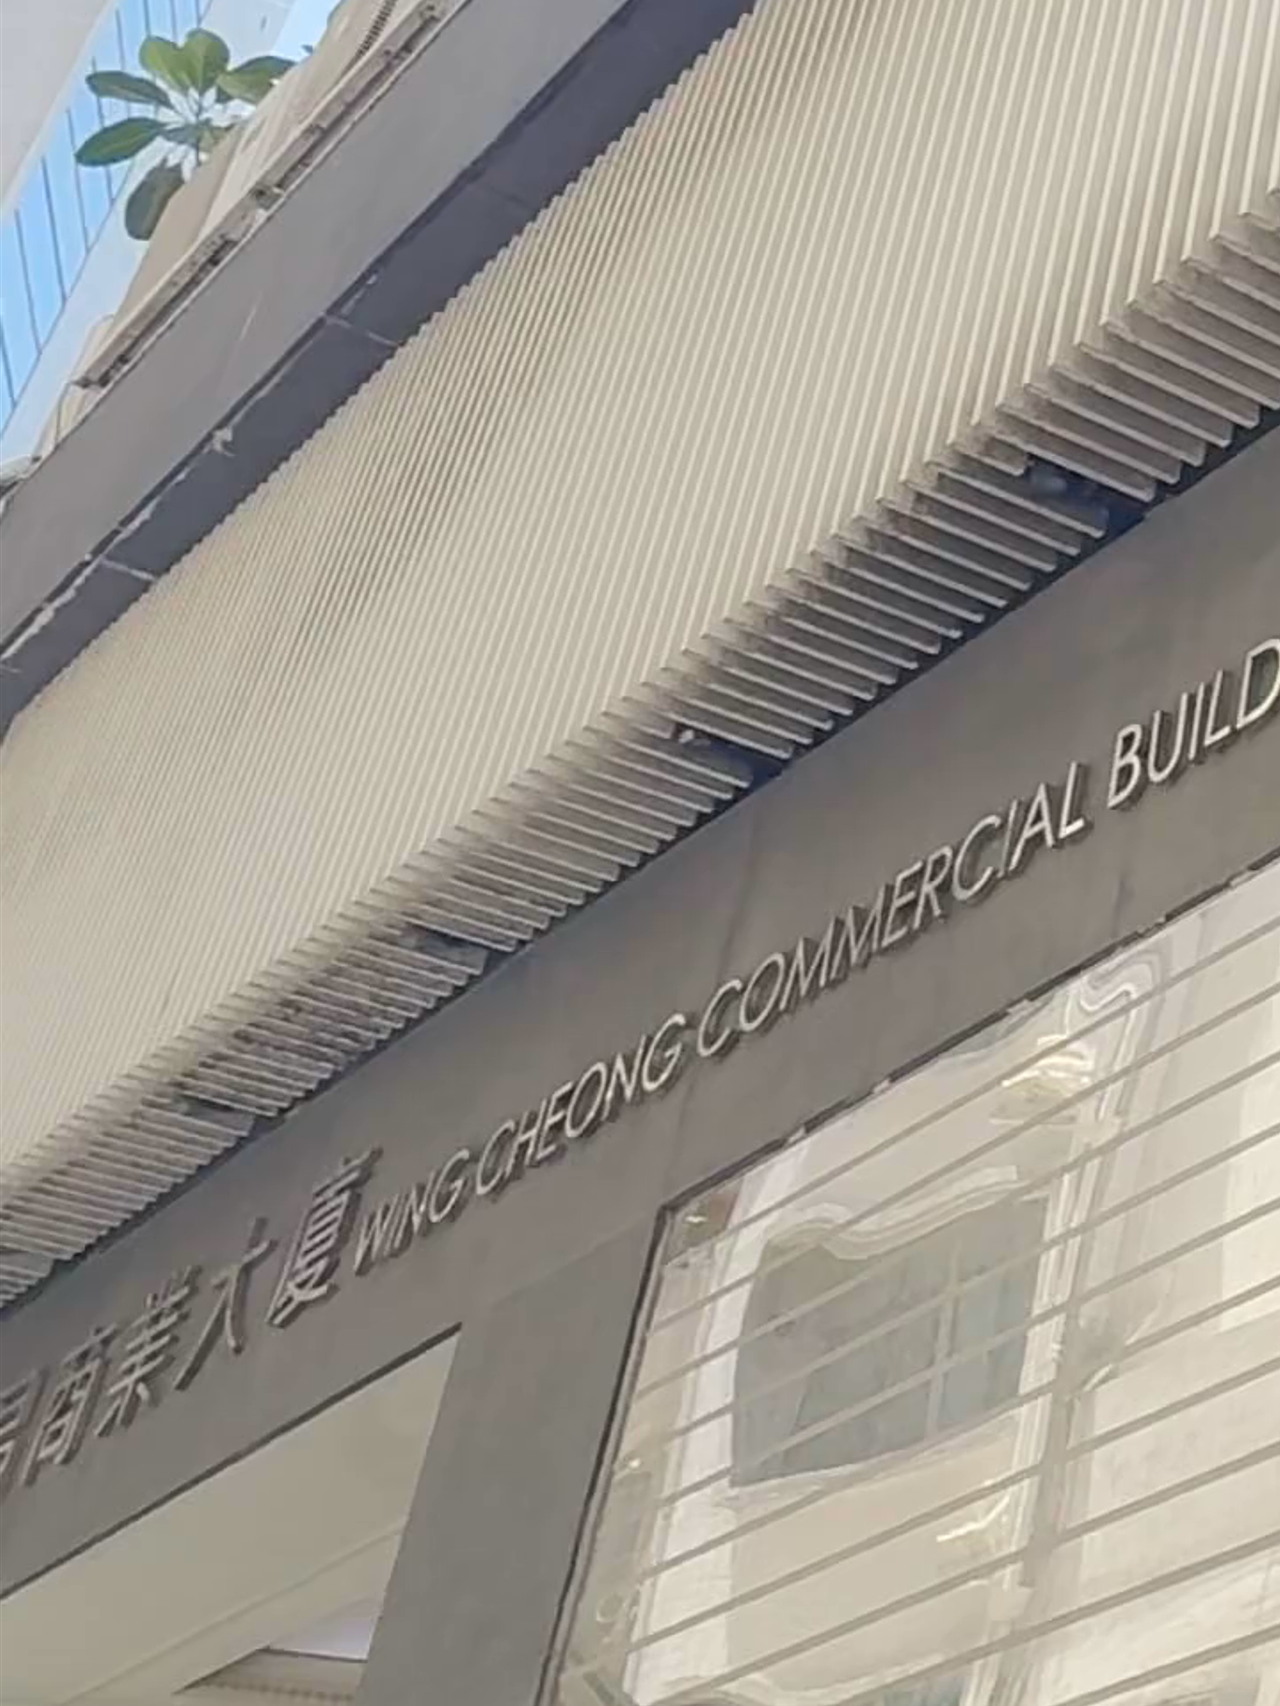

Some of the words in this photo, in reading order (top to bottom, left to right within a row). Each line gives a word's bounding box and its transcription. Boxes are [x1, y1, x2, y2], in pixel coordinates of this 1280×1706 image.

[353, 1147, 470, 1275] WING
[475, 1013, 687, 1196] CHEONG
[697, 761, 1087, 1058] COMMERCIAL
